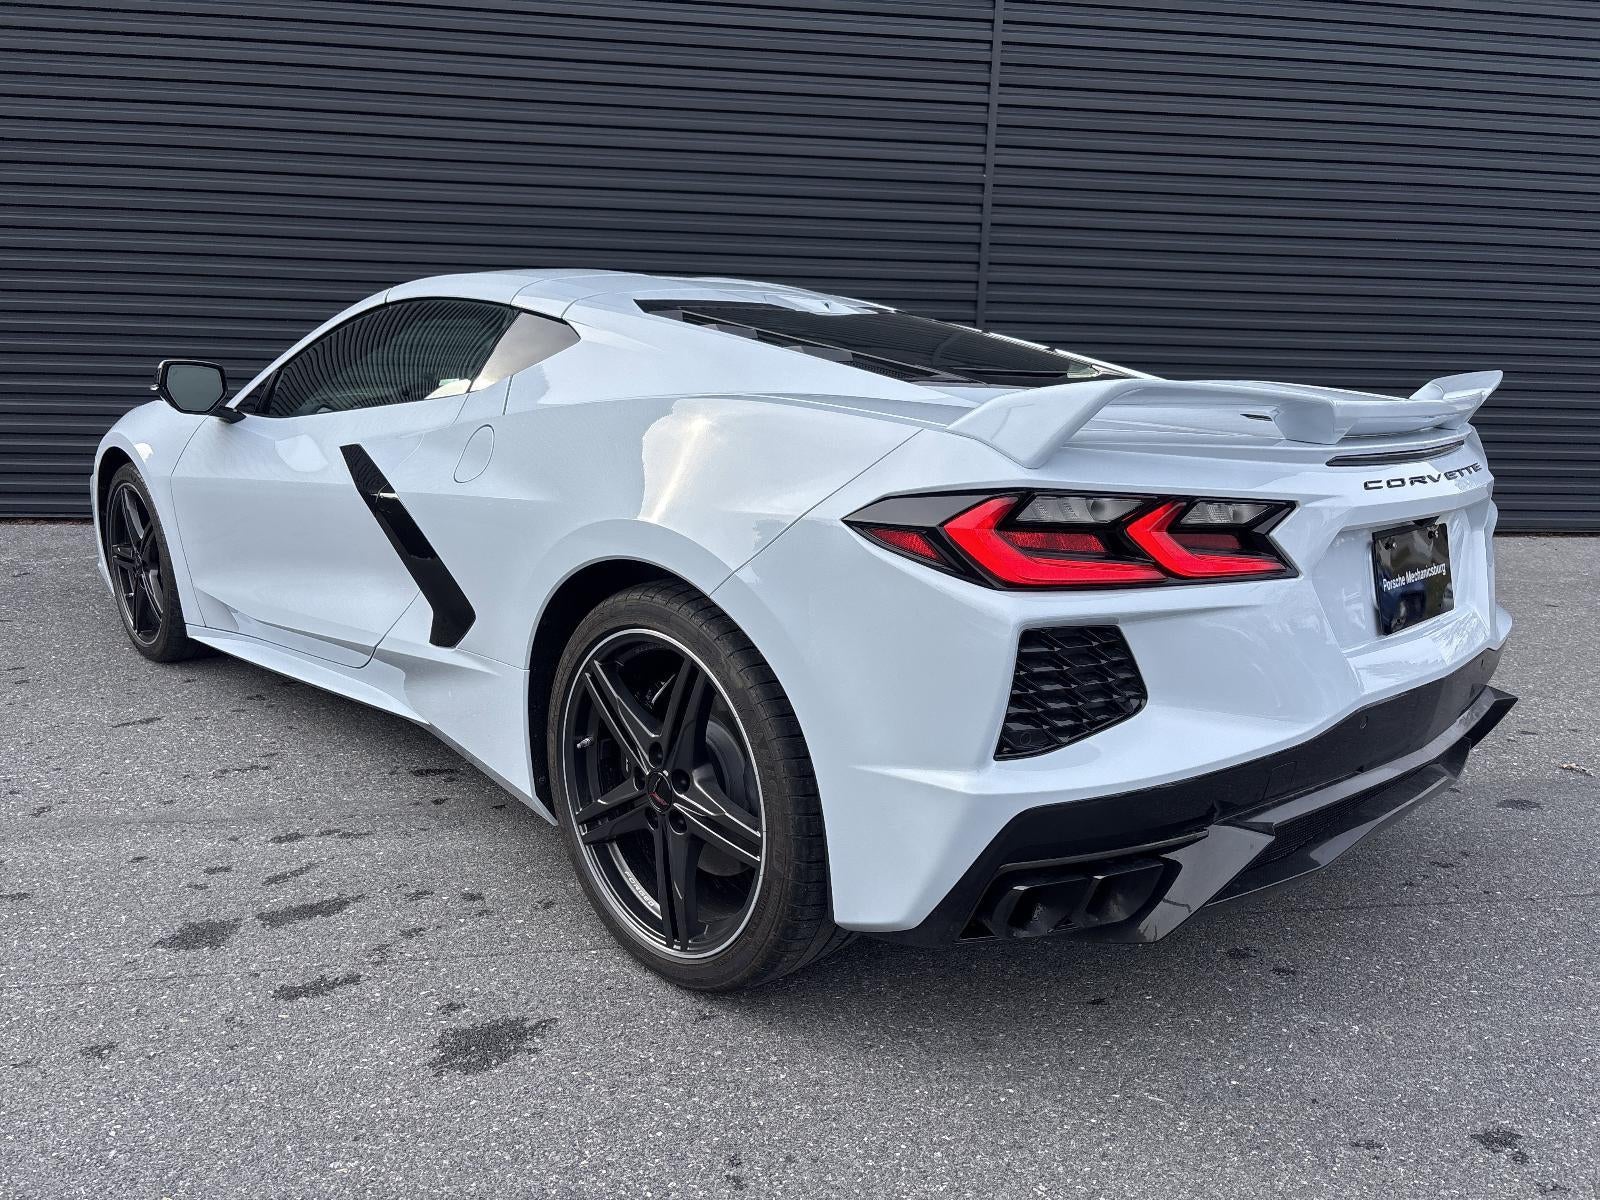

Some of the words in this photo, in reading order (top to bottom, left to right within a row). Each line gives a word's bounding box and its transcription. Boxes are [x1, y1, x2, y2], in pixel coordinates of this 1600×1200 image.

[1364, 463, 1482, 490] CORVETTE
[1383, 573, 1406, 592] Porsche
[1406, 563, 1446, 584] Mechanicsburg
